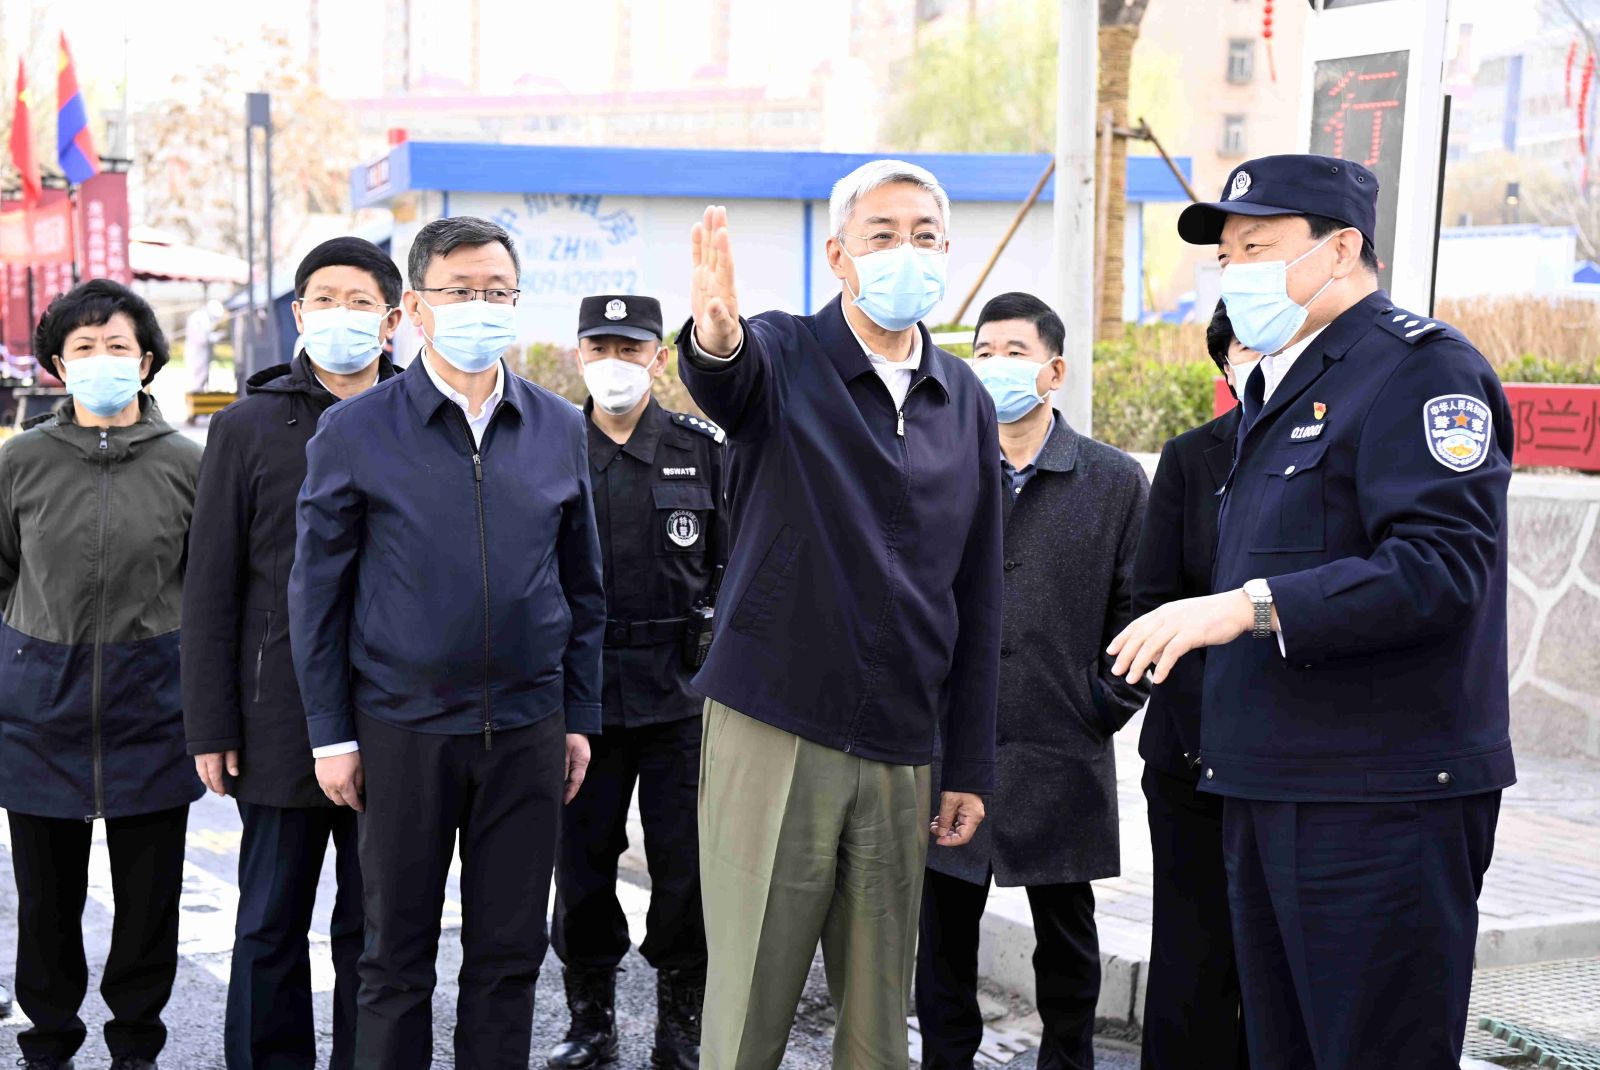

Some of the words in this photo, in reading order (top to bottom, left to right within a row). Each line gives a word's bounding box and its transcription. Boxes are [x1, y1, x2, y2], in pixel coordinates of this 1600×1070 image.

[1430, 400, 1487, 420] 中华人民共和国
